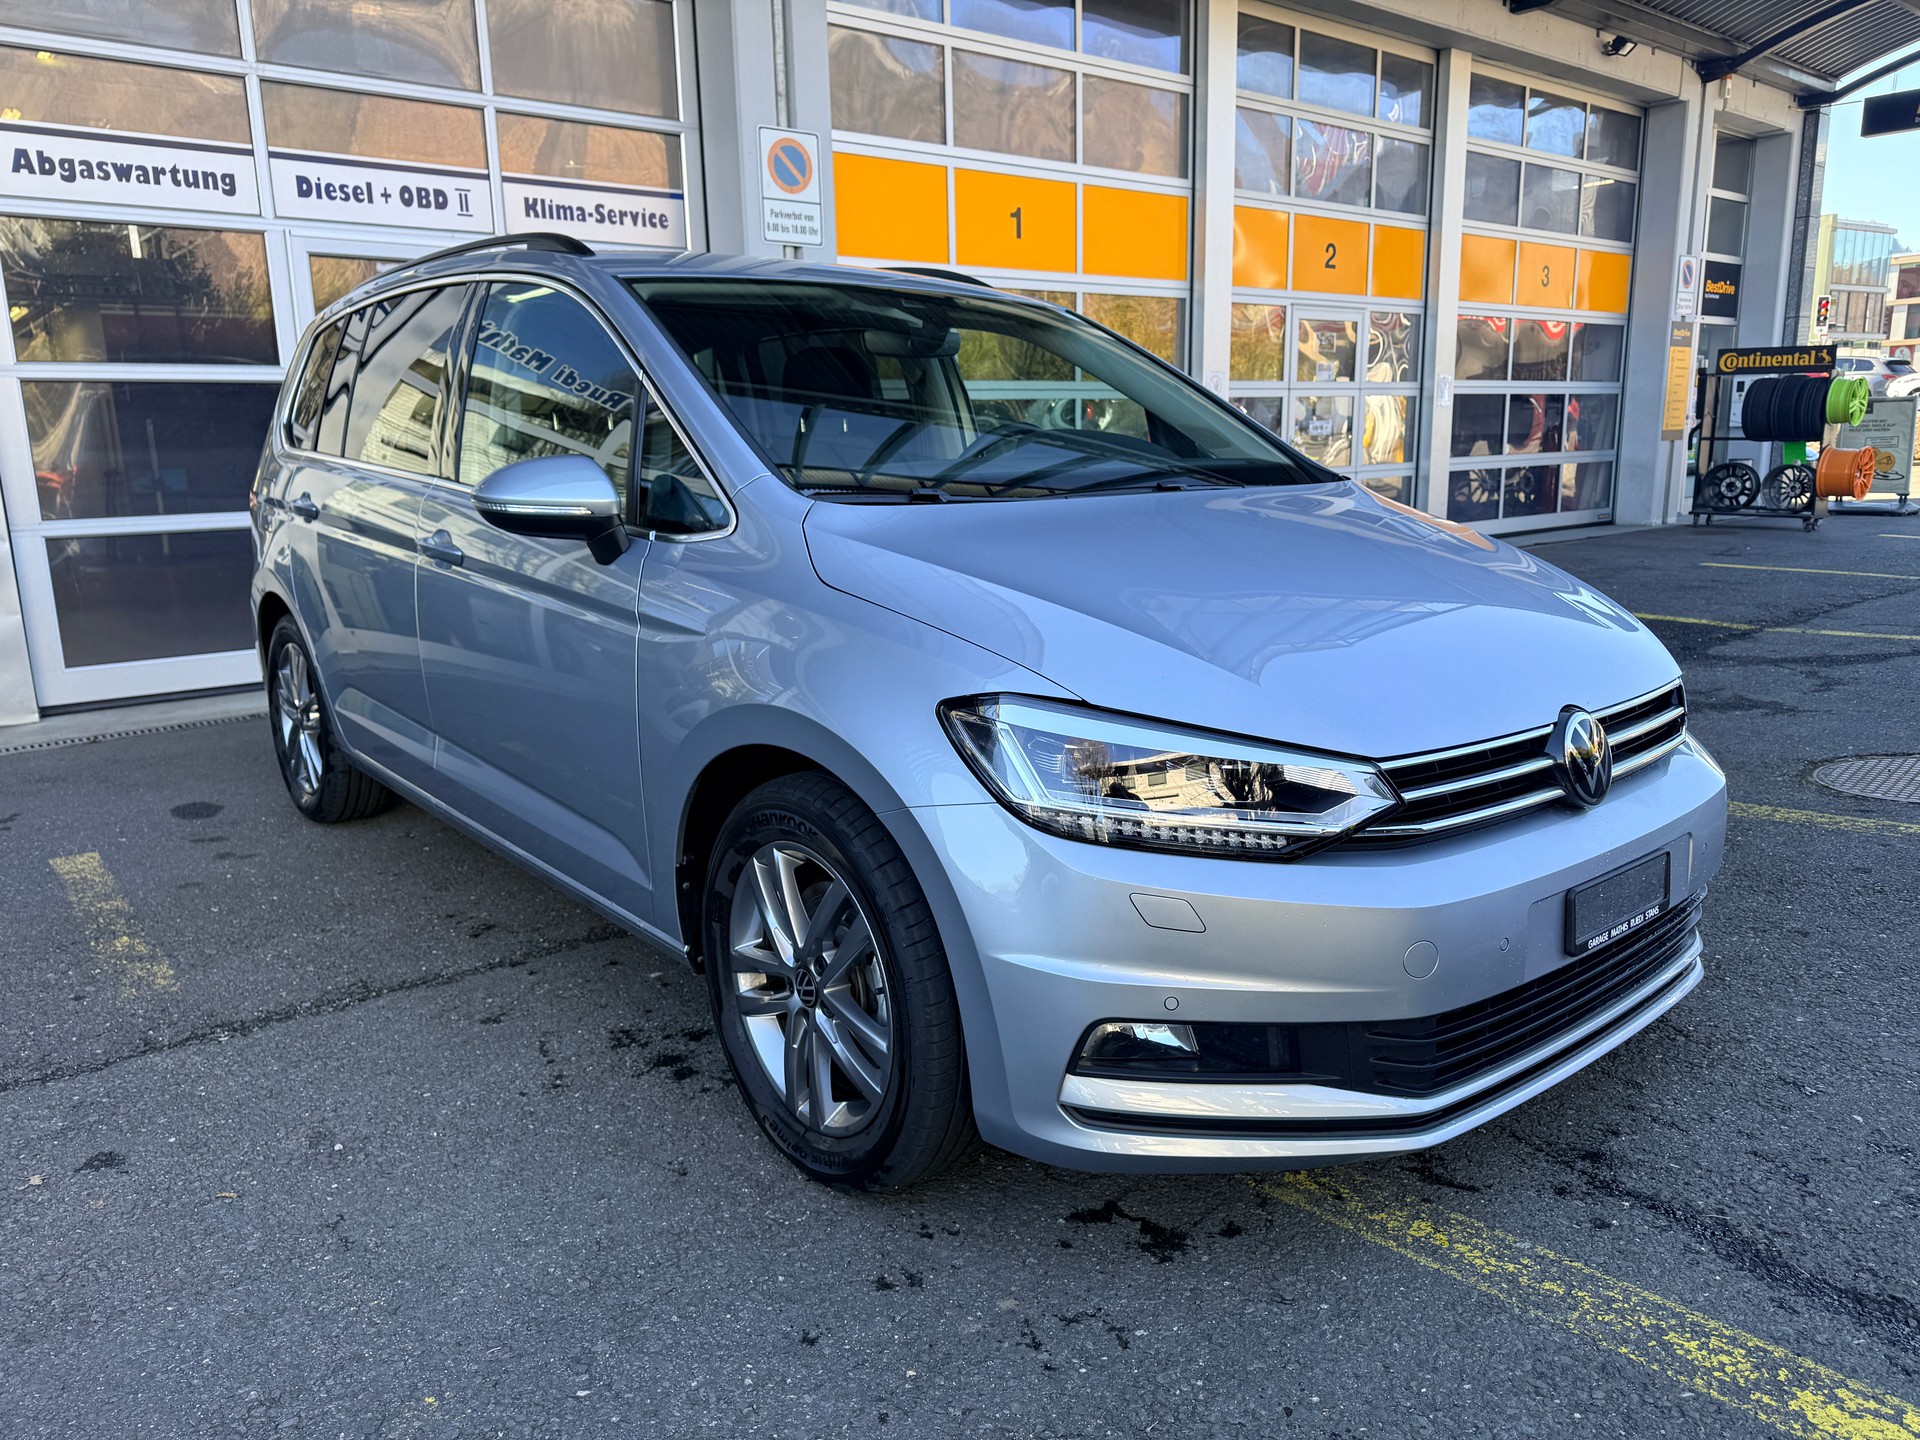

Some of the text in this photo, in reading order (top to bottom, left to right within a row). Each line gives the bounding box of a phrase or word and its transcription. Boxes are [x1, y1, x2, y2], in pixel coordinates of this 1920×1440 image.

[12, 148, 237, 197] Abgaswartung
[295, 175, 474, 217] Diesel + OBD II
[523, 196, 670, 230] Klima-Service
[770, 208, 803, 221] Parkverbot
[1010, 207, 1021, 239] 1
[781, 222, 790, 233] bis
[808, 225, 819, 236] Uhr
[1325, 243, 1336, 269] 2
[1541, 265, 1550, 287] 3
[1705, 280, 1735, 295] BestDrive
[1719, 350, 1816, 373] Continental
[1588, 905, 1660, 949] GARAGE MATHIS RUEDI STANS
